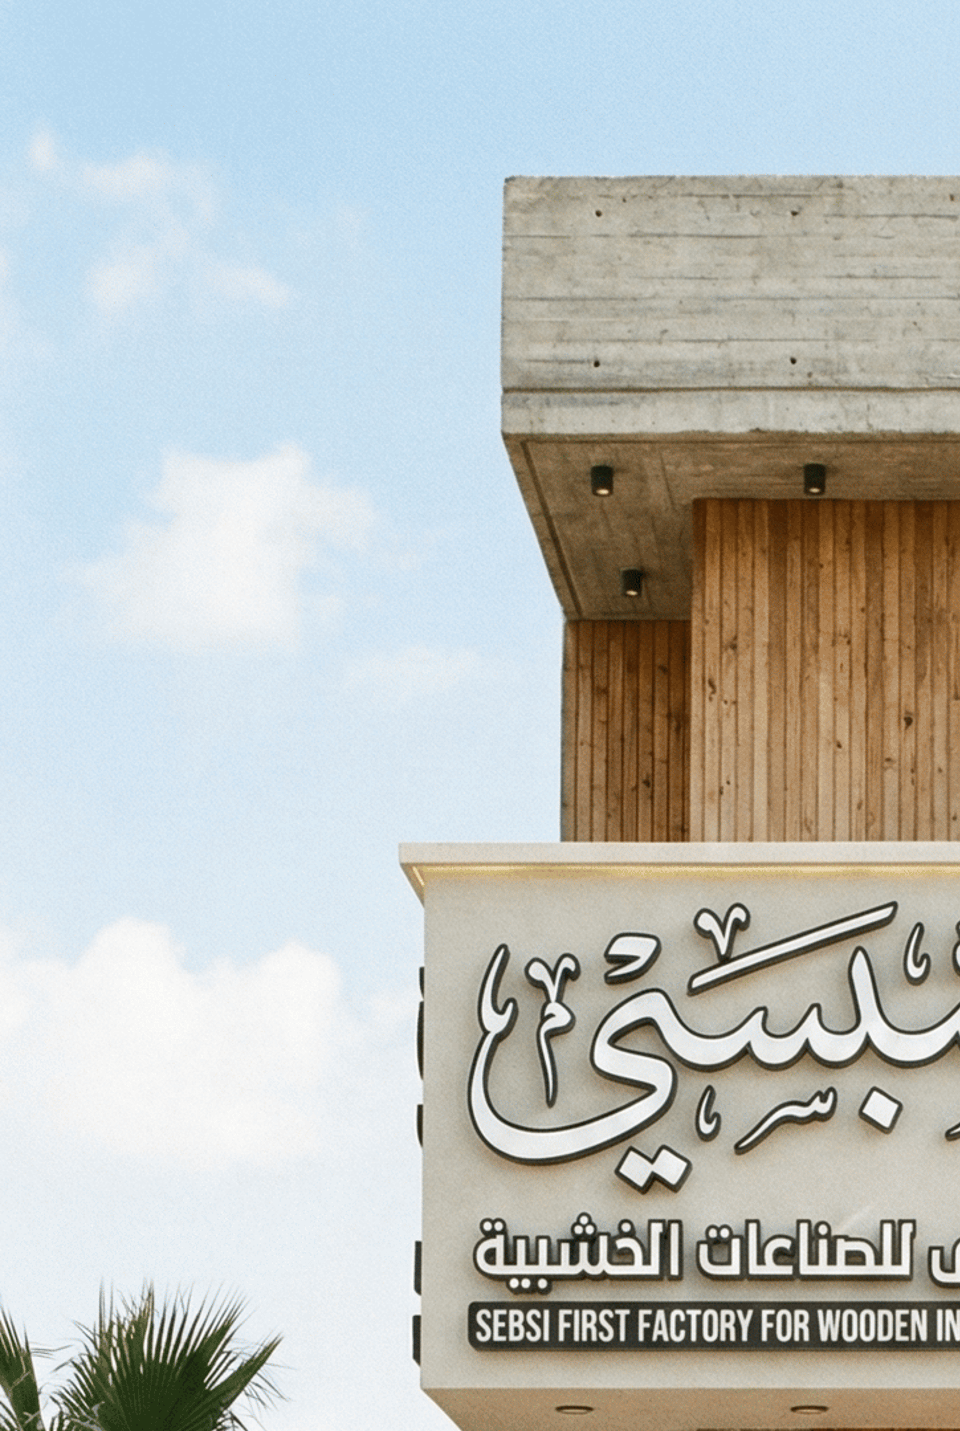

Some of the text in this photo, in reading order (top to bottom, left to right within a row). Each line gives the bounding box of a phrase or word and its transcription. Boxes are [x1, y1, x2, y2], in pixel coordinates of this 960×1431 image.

[473, 1212, 683, 1294] الخشبية
[696, 1219, 916, 1282] للصناعات
[475, 1308, 550, 1342] SEBSI
[558, 1308, 630, 1342] FIRST
[638, 1308, 753, 1342] FACTORY
[761, 1308, 809, 1342] FOR
[817, 1308, 928, 1342] WOODEN
